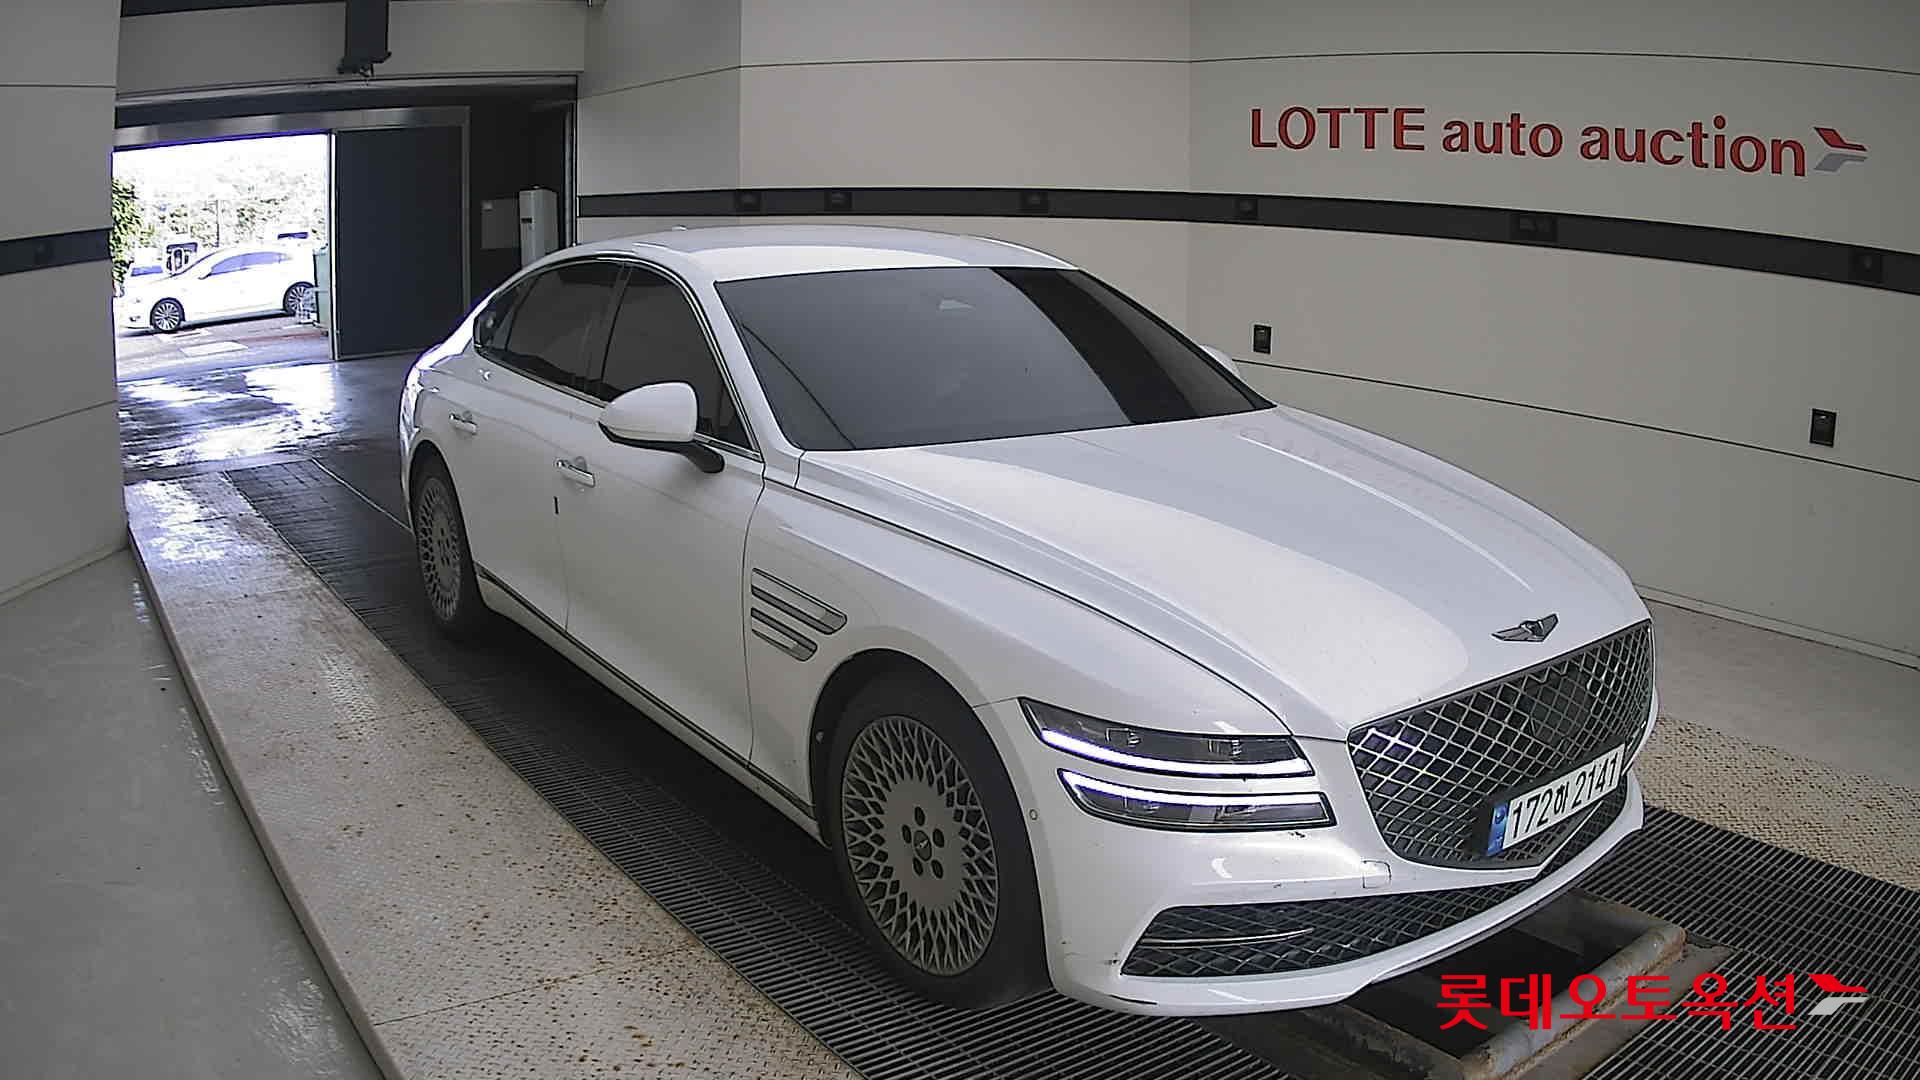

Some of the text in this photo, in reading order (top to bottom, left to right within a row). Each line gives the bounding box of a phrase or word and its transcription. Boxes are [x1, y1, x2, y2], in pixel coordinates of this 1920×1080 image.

[1250, 106, 1807, 177] LOTTE auto auction
[1571, 751, 1619, 810] 2141
